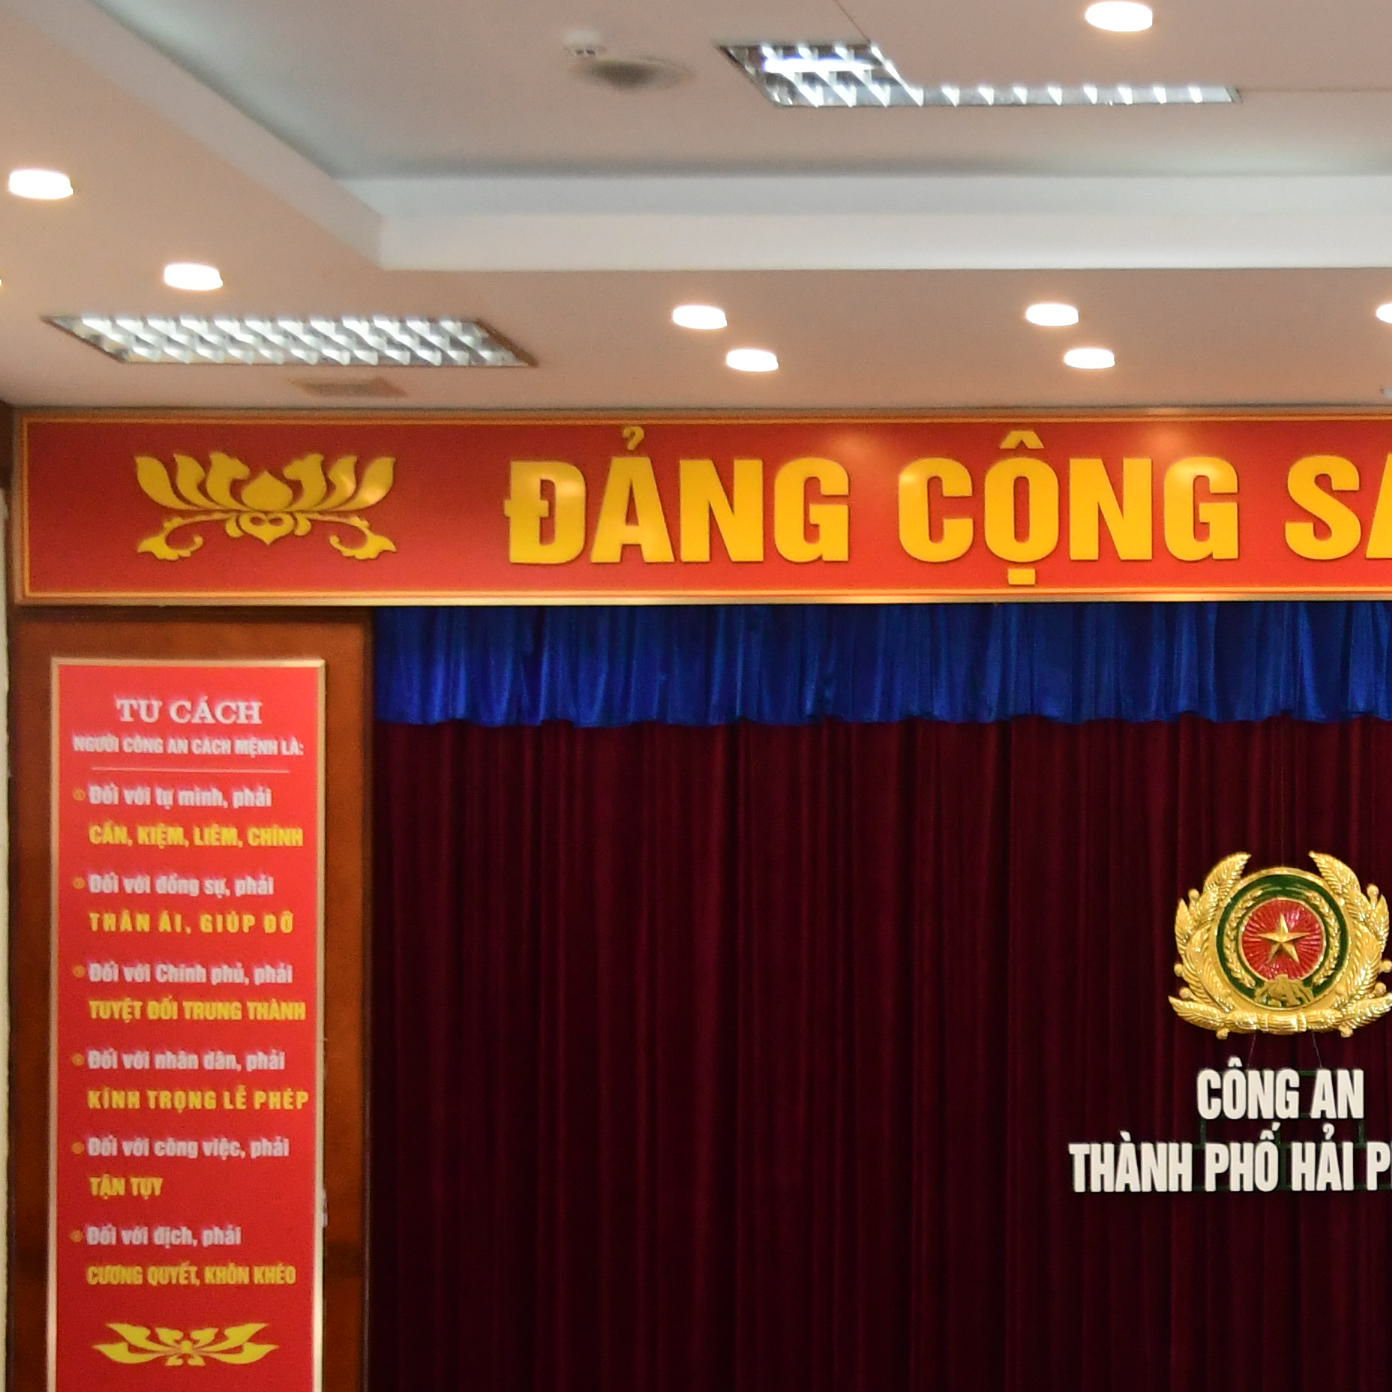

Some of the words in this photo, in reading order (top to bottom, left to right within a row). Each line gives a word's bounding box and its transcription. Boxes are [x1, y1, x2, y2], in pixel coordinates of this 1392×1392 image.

[505, 426, 850, 565] ĐẢNG
[898, 430, 1240, 586] CỘNG
[169, 695, 263, 725] CÁCH
[167, 738, 190, 755] AN
[123, 786, 152, 807] với
[137, 823, 190, 850] KIỆM,
[194, 823, 244, 848] LIÊM,
[248, 826, 305, 848] CHÍNH
[123, 876, 152, 895] với
[200, 912, 257, 934] GIÚP
[124, 965, 152, 984] với
[90, 998, 144, 1024] TUYỆT
[184, 1001, 244, 1022] TRUNG
[248, 999, 307, 1022] THÀNH
[123, 1052, 151, 1071] với
[1196, 1056, 1300, 1120] CÔNG
[1310, 1069, 1365, 1120] AN
[88, 1088, 141, 1110] KÍNH
[147, 1091, 218, 1114] TRỌNG
[254, 1088, 310, 1111] PHÉP
[123, 1139, 150, 1158] với
[1069, 1130, 1193, 1193] THÀNH
[1204, 1121, 1280, 1192] PHỐ
[1290, 1124, 1355, 1192] HẢI
[90, 1174, 127, 1200] TẬN
[122, 1227, 149, 1246] với
